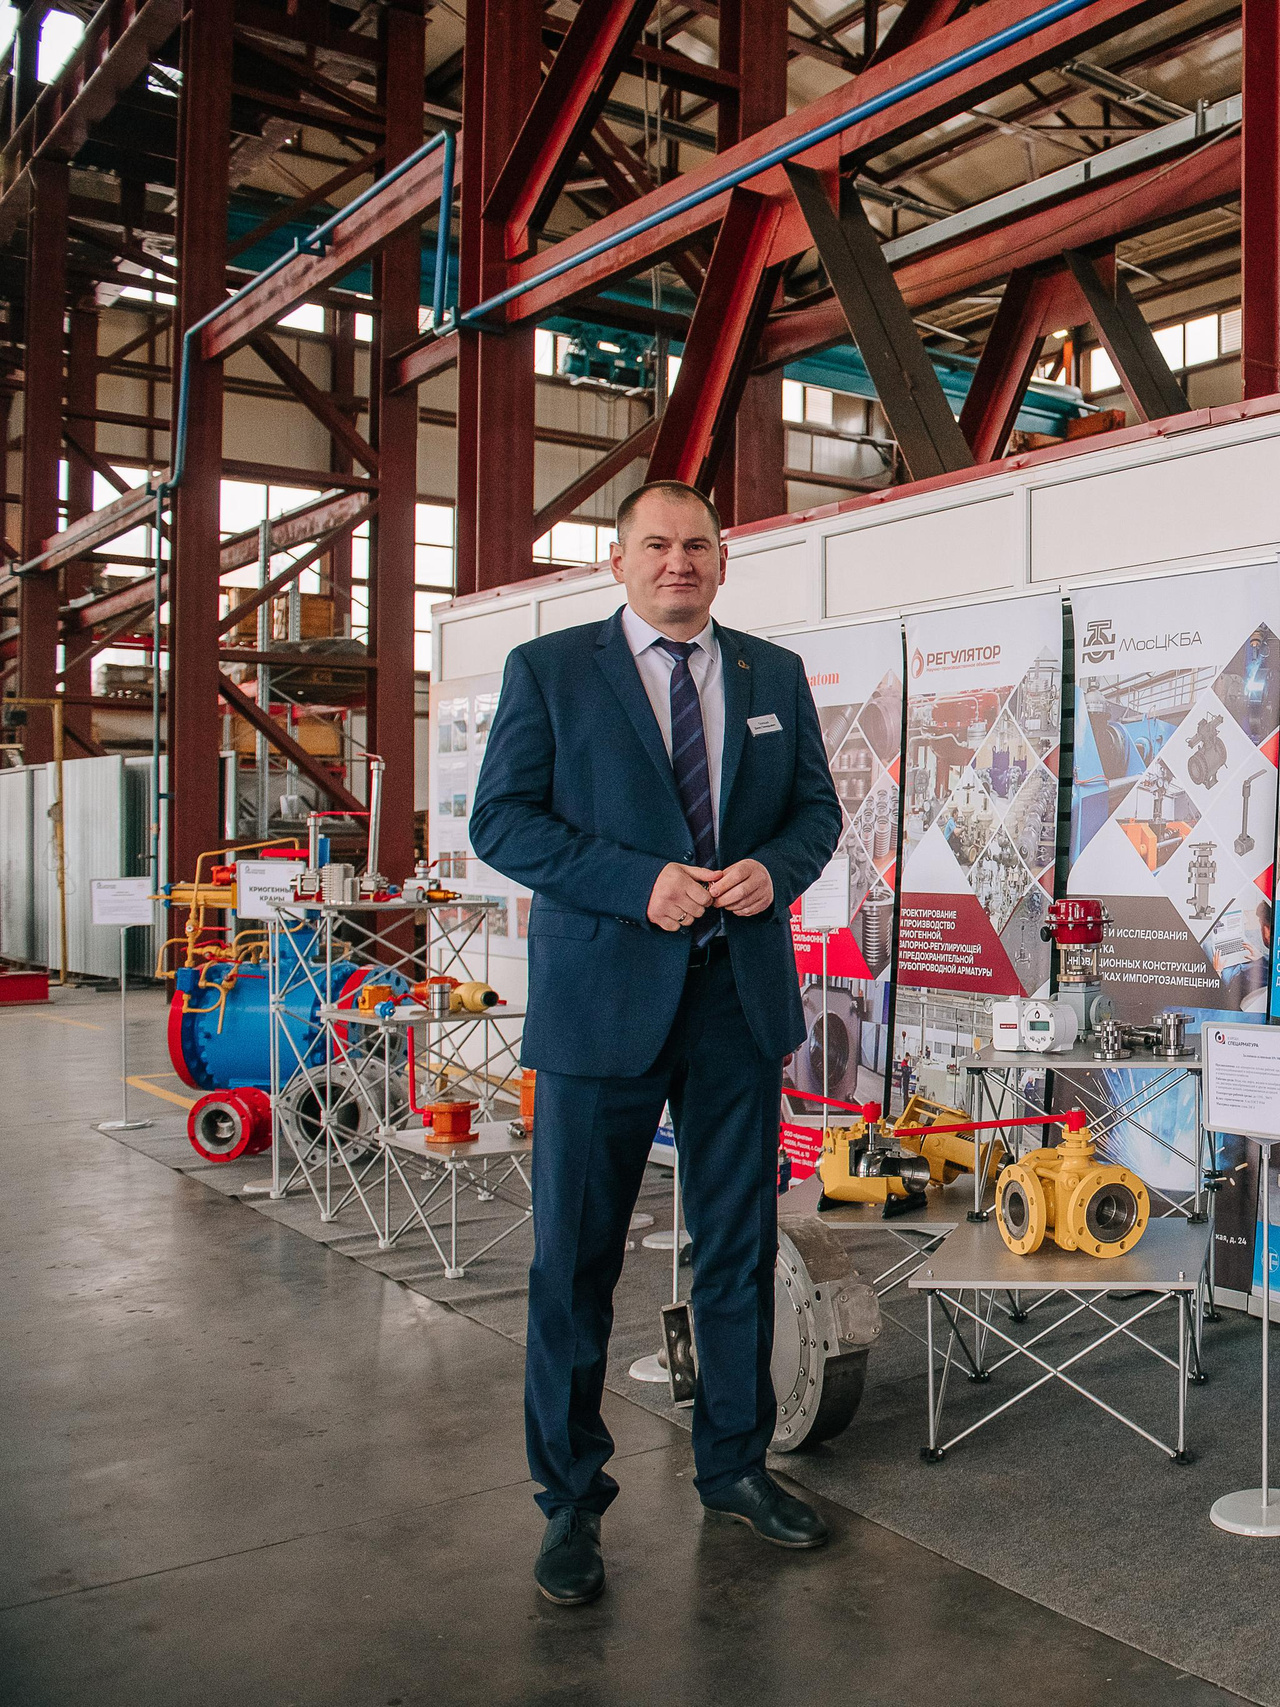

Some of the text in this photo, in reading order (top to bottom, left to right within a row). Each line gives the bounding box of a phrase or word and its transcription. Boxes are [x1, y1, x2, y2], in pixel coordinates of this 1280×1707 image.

[1119, 631, 1202, 652] МосЦКБА
[927, 645, 1001, 666] РЕГУЛЯТОР
[807, 672, 840, 686] atom
[904, 919, 956, 930] ПРОИЗВОДСТВО
[1109, 929, 1115, 937] И
[1116, 928, 1188, 941] ИССЛЕДОВАНИЯ
[794, 943, 811, 952] ТОРОВ
[903, 951, 974, 964] ПРЕДОХРАНИТЕЛЬНОЙ
[957, 966, 993, 977] АРМАТУРЫ
[1142, 960, 1207, 974] КОНСТРУКЦИЙ
[1122, 974, 1220, 989] ИМПОРТОЗАМЕЩЕНИЯ
[1215, 1233, 1247, 1245] кая, д. 24
